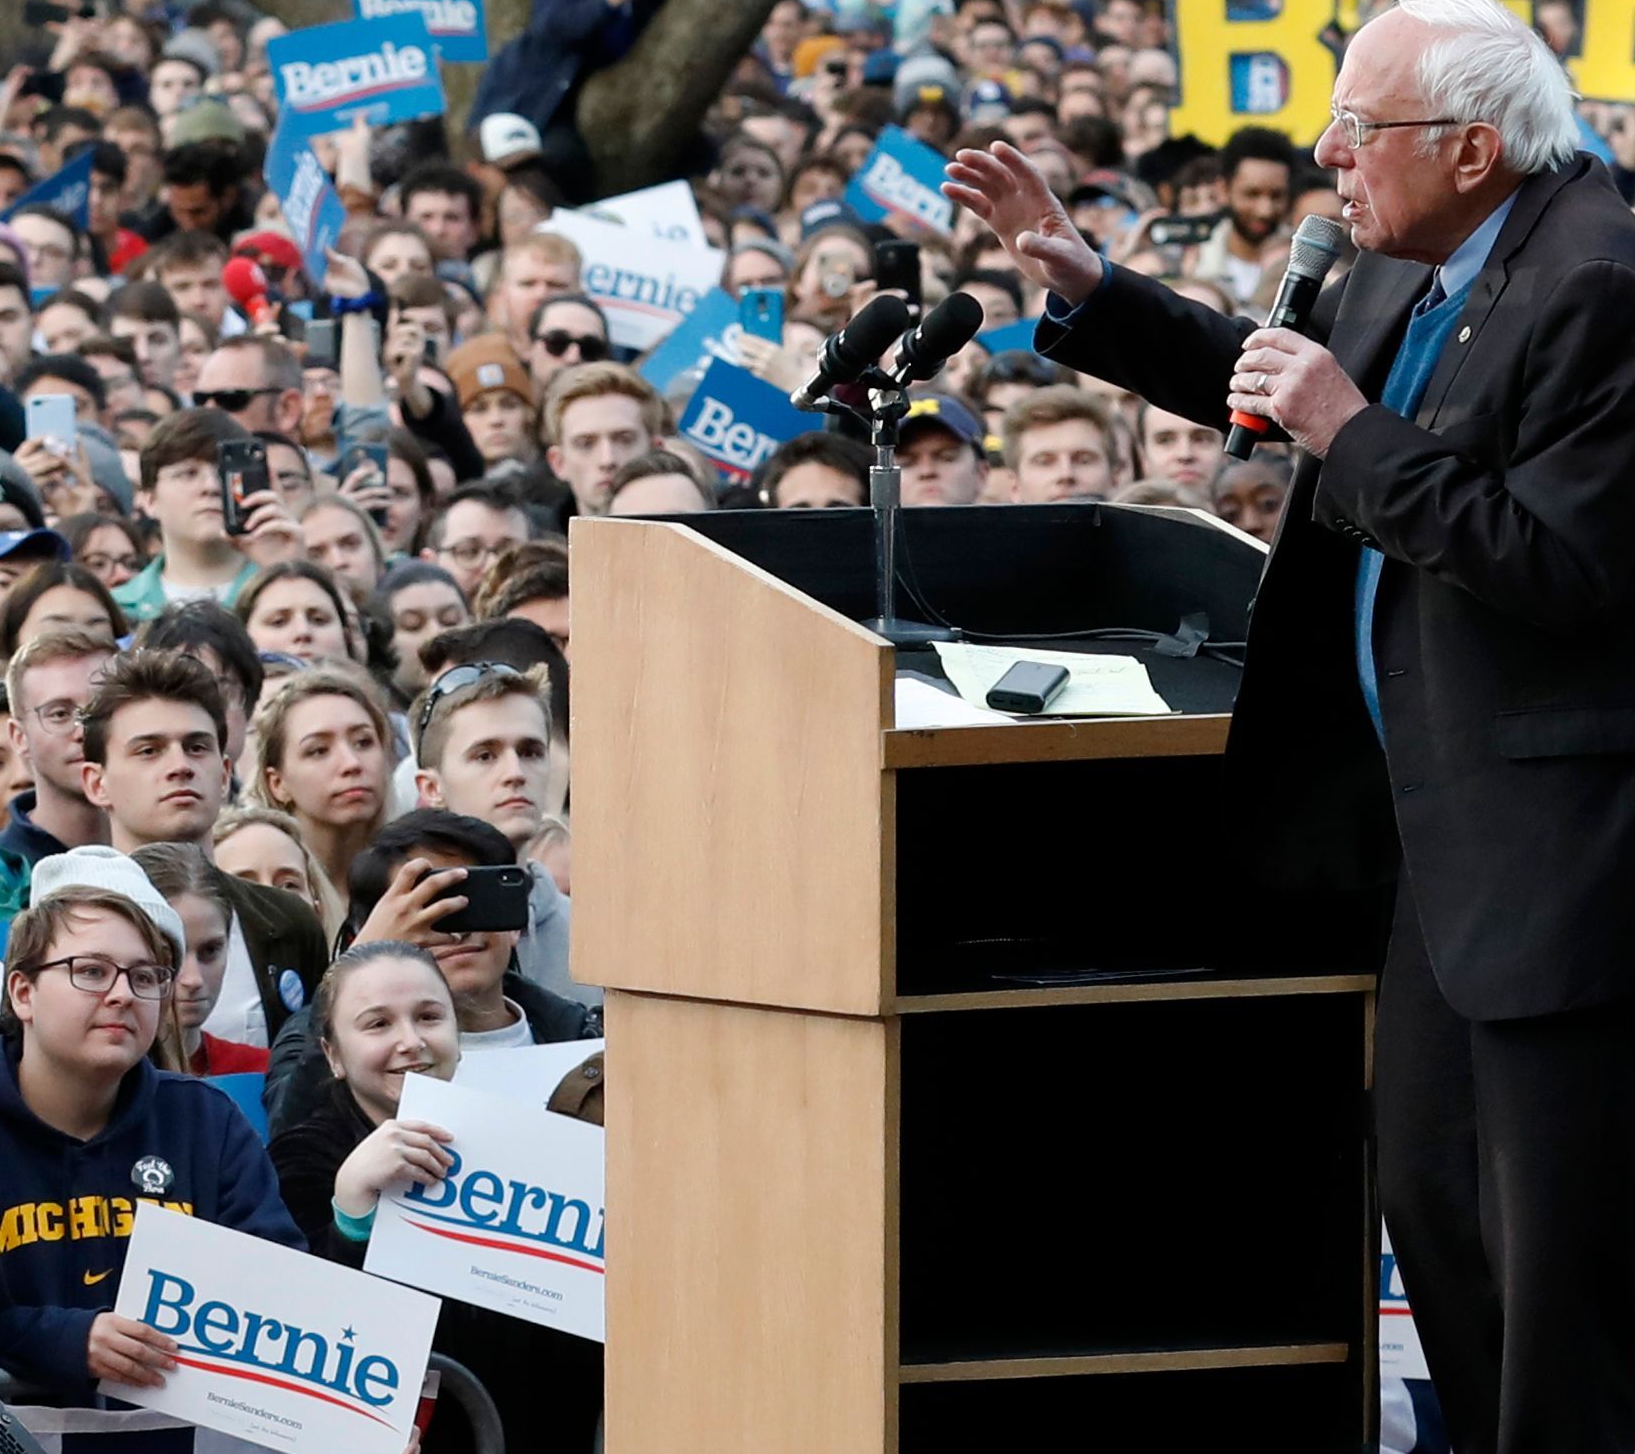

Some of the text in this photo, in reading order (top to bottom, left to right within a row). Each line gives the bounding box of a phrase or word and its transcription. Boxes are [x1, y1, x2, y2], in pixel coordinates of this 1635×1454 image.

[280, 42, 428, 106] Bernie
[863, 152, 955, 237] Bern
[585, 260, 697, 326] ernie
[686, 396, 779, 471] Ber
[469, 1274, 564, 1313] BernieSanders.com
[135, 1268, 400, 1407] Bernie
[206, 1390, 304, 1431] BernieSanders.com
